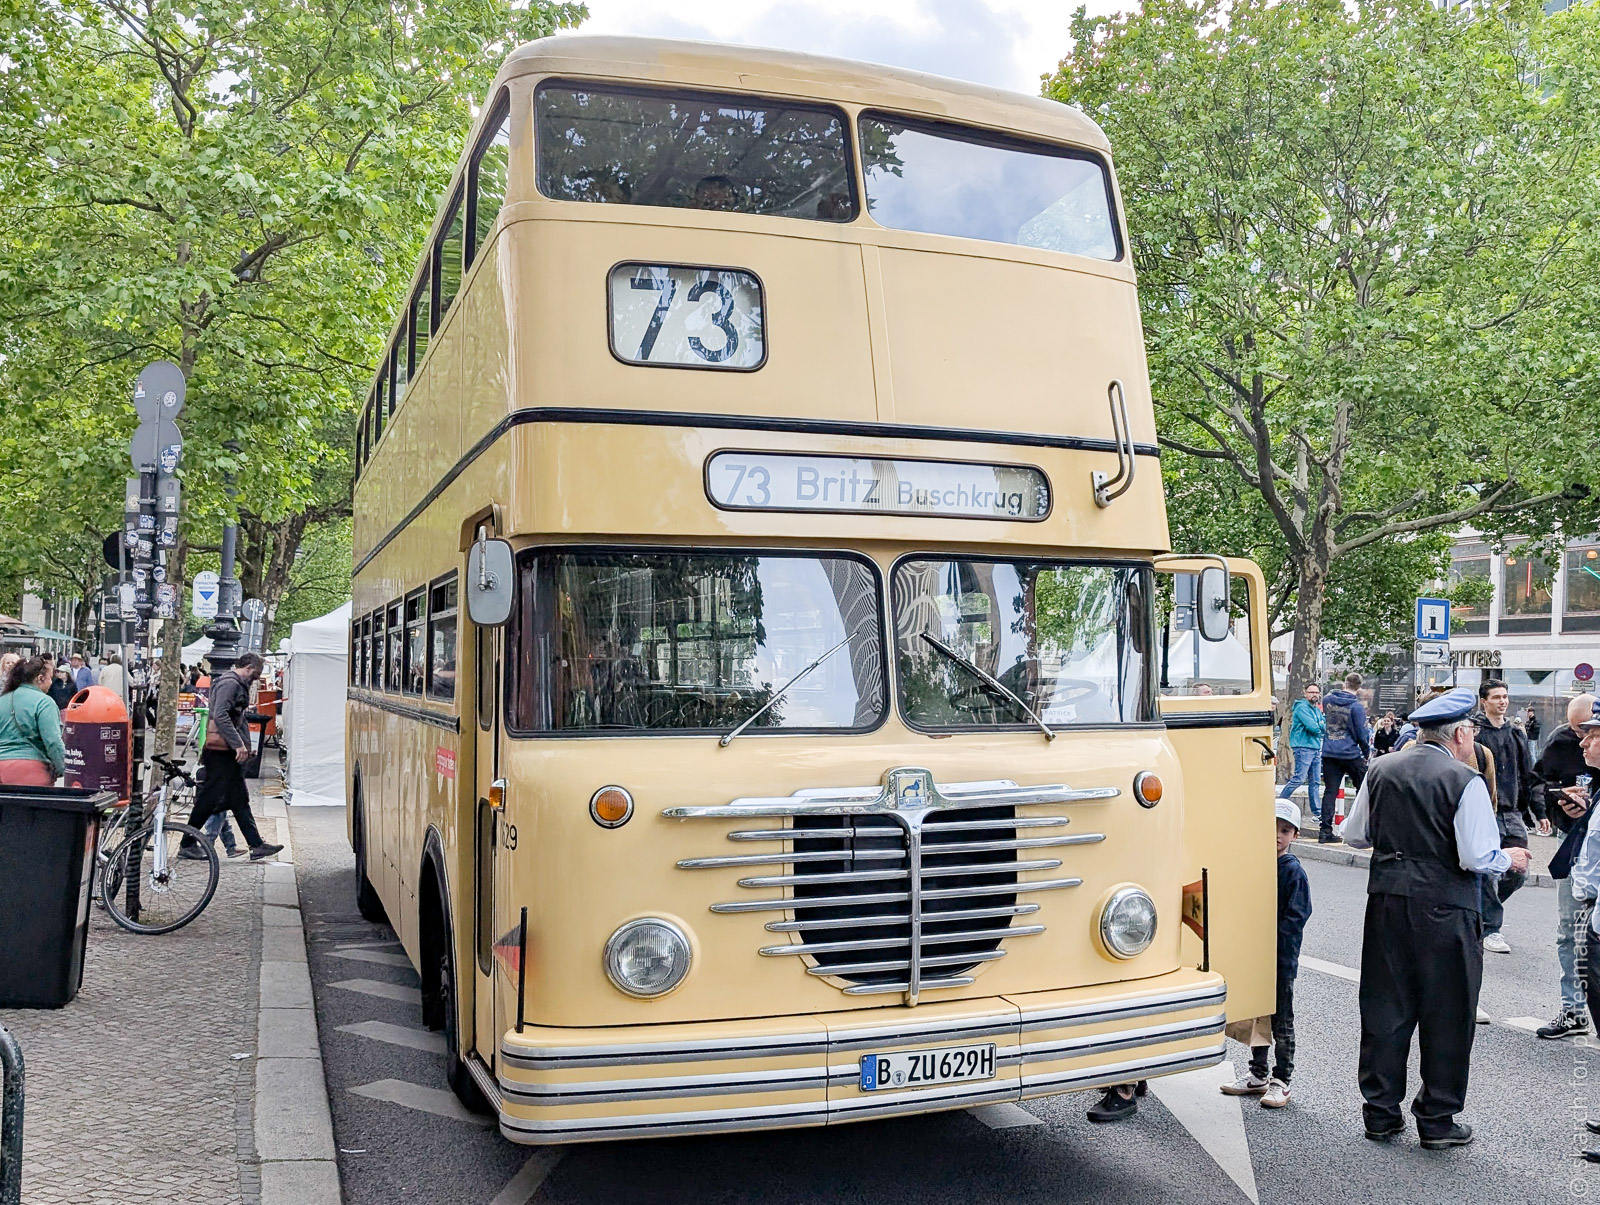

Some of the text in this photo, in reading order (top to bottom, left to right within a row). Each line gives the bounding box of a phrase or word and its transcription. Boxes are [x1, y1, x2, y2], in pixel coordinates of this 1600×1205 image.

[630, 277, 739, 363] 73
[724, 463, 1023, 516] 73 Britz Buschkrug
[877, 1058, 891, 1085] B
